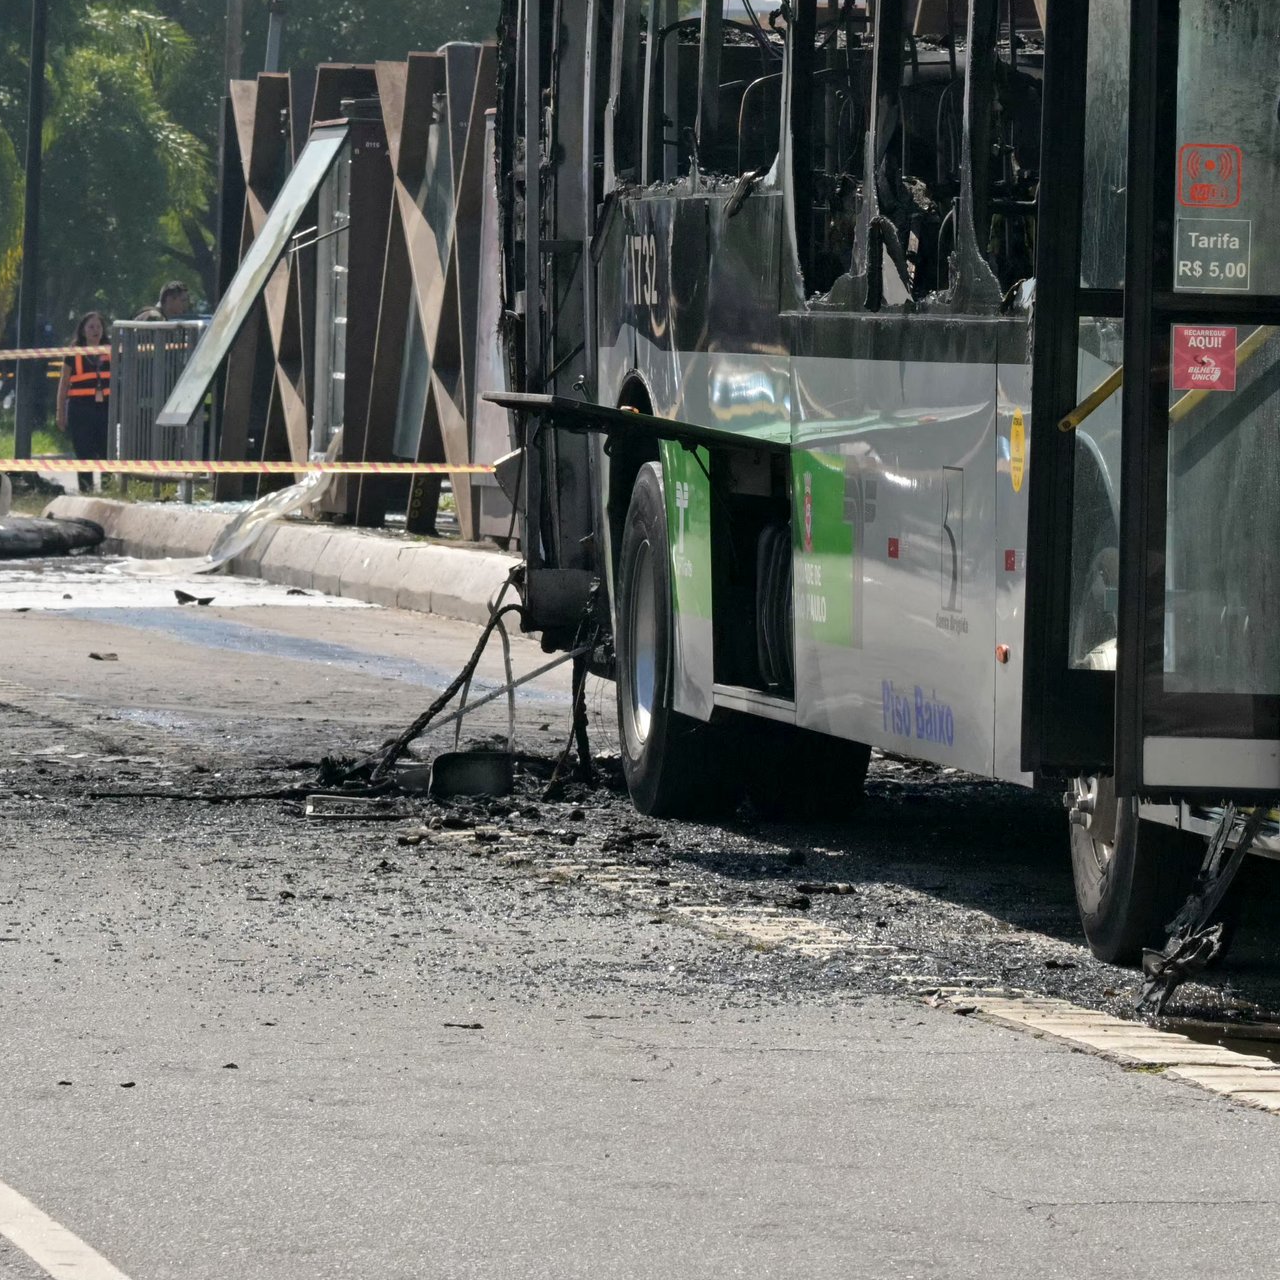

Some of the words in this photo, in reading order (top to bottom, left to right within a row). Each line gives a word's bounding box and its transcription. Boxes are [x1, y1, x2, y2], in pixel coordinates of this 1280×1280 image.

[1188, 232, 1240, 250] Tarifa
[1178, 260, 1203, 279] R$
[1209, 262, 1247, 280] 5,00
[1188, 336, 1222, 350] AQUI!
[882, 679, 911, 738] Piso
[914, 685, 954, 748] Baixo
